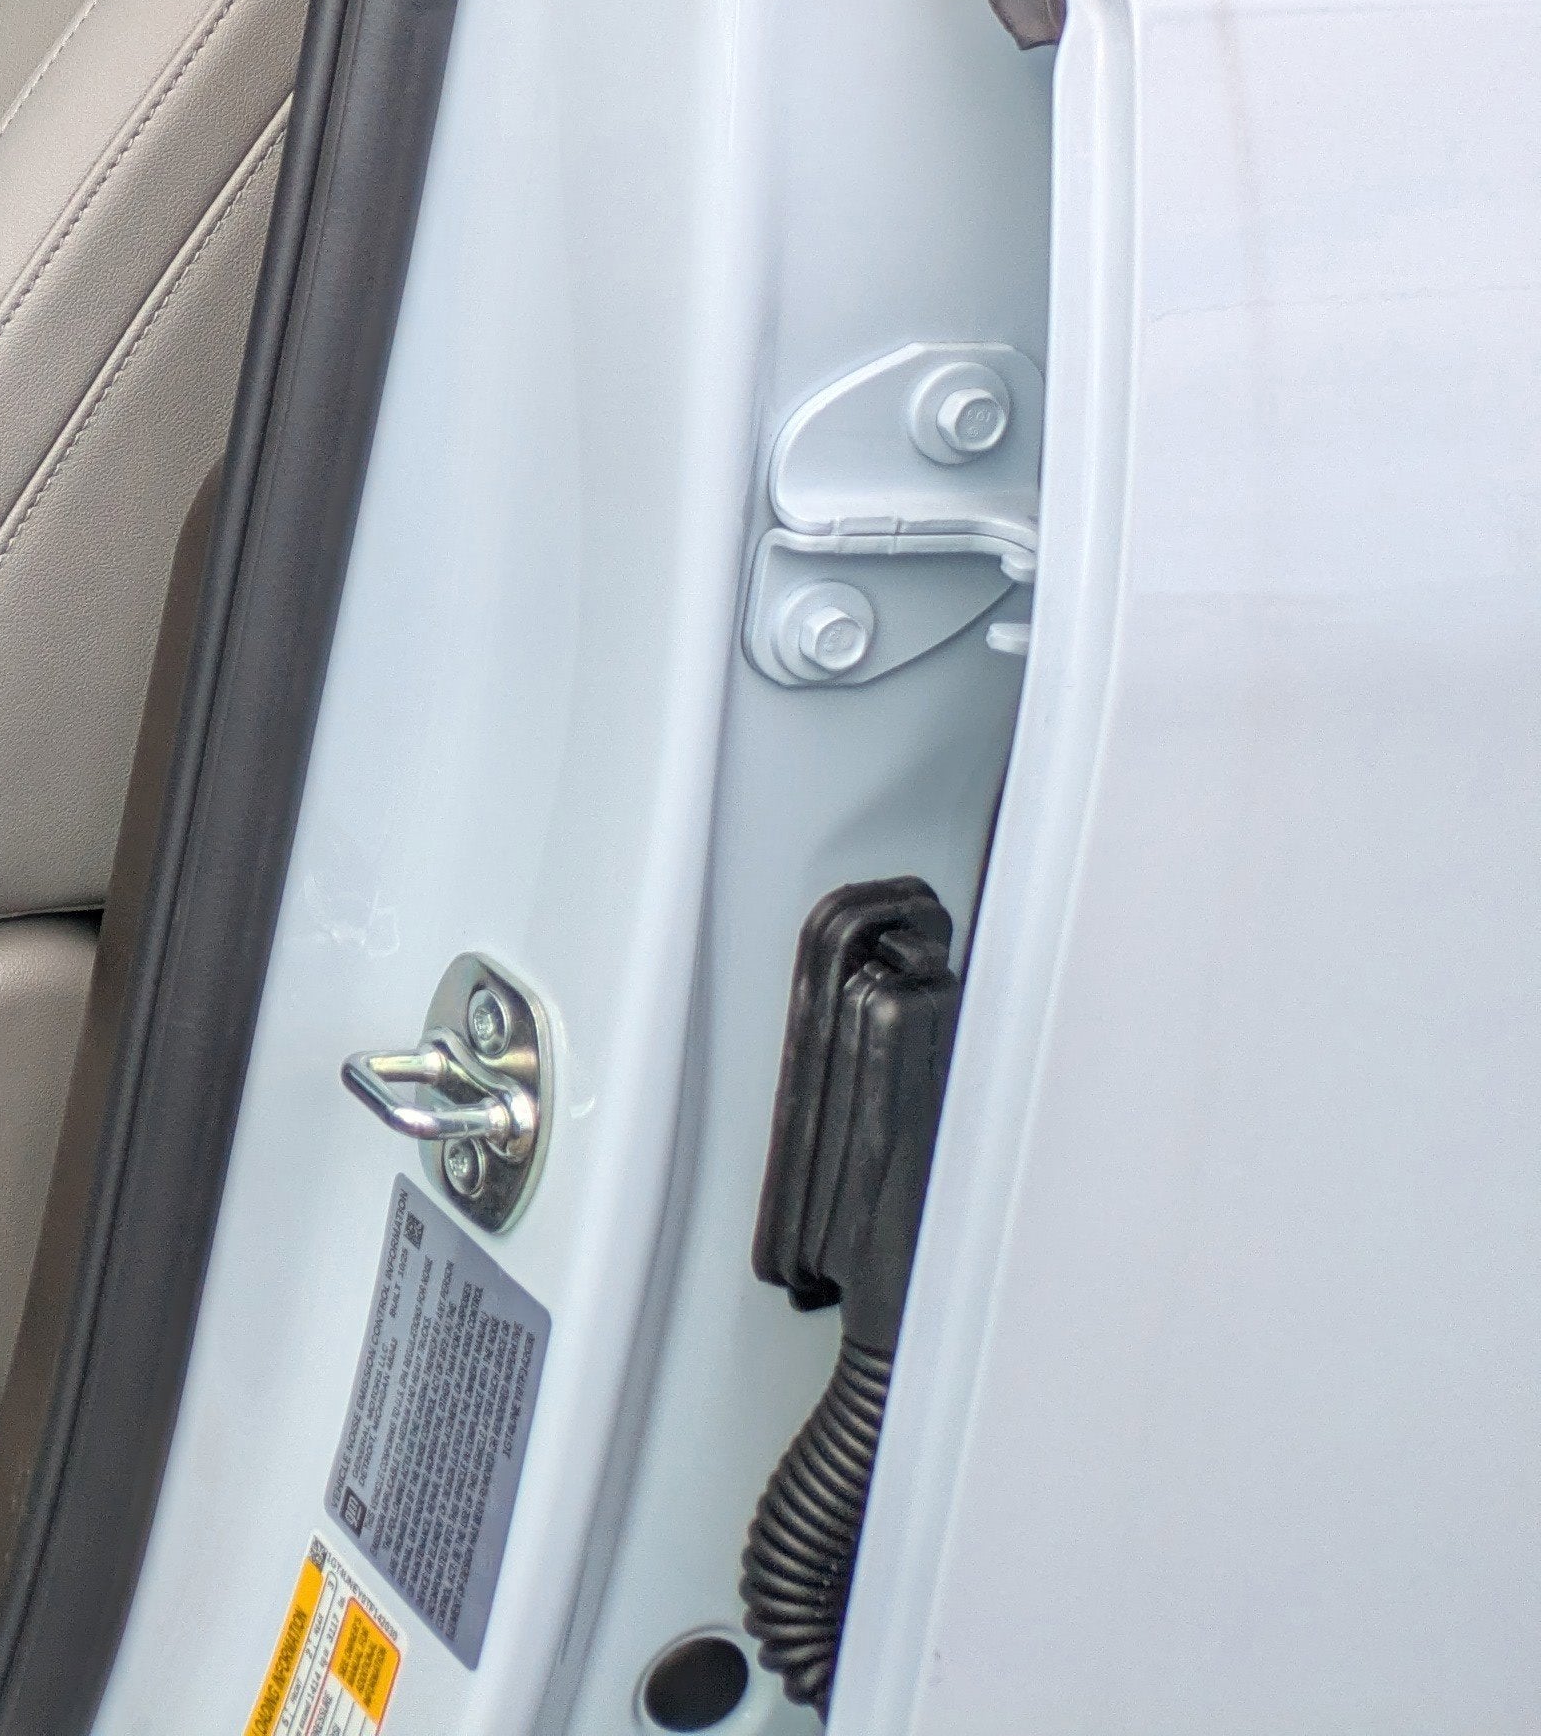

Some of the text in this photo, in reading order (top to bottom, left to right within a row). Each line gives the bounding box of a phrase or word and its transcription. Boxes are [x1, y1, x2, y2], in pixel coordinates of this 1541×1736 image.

[440, 1260, 454, 1299] PERSON
[436, 1299, 445, 1320] ANY
[455, 1281, 471, 1332] PURPOSES
[432, 1320, 440, 1335] BY
[451, 1332, 460, 1353] FOR
[457, 1359, 465, 1380] ANY
[461, 1331, 473, 1359] NOISE
[467, 1286, 483, 1329] CONTROL
[331, 1189, 407, 1507] VEHICLE NOISE EMISSION CONTROL INFORMATION
[423, 1336, 437, 1376] THEREOF
[445, 1353, 456, 1378] THAN
[352, 1425, 370, 1478] GENERAL
[366, 1369, 382, 1419] MOTORS
[378, 1342, 387, 1368] LLC
[389, 1282, 400, 1318] BUILT
[370, 1470, 384, 1510] VEHICLE
[379, 1421, 396, 1471] CONFORMS
[391, 1406, 400, 1419] TO
[403, 1305, 421, 1368] REGULATIONS
[416, 1284, 426, 1305] FOR
[421, 1255, 433, 1285] NOISE
[414, 1379, 428, 1419] CAUSING
[421, 1397, 436, 1439] CONTROL
[431, 1373, 439, 1395] ACT
[435, 1360, 443, 1375] OF
[438, 1379, 450, 1412] OTHER
[372, 1373, 390, 1431] MICHIGAN
[459, 1399, 470, 1416] THE
[382, 1458, 398, 1513] APPLICABLE
[394, 1442, 402, 1455] TO
[398, 1406, 410, 1442] MEDIUM
[406, 1385, 415, 1405] AND
[411, 1354, 421, 1385] HEAVY
[409, 1420, 419, 1437] THE
[387, 1481, 405, 1532] FOLLOWING
[382, 1533, 392, 1549] THE
[272, 1609, 306, 1688] INFORMATION
